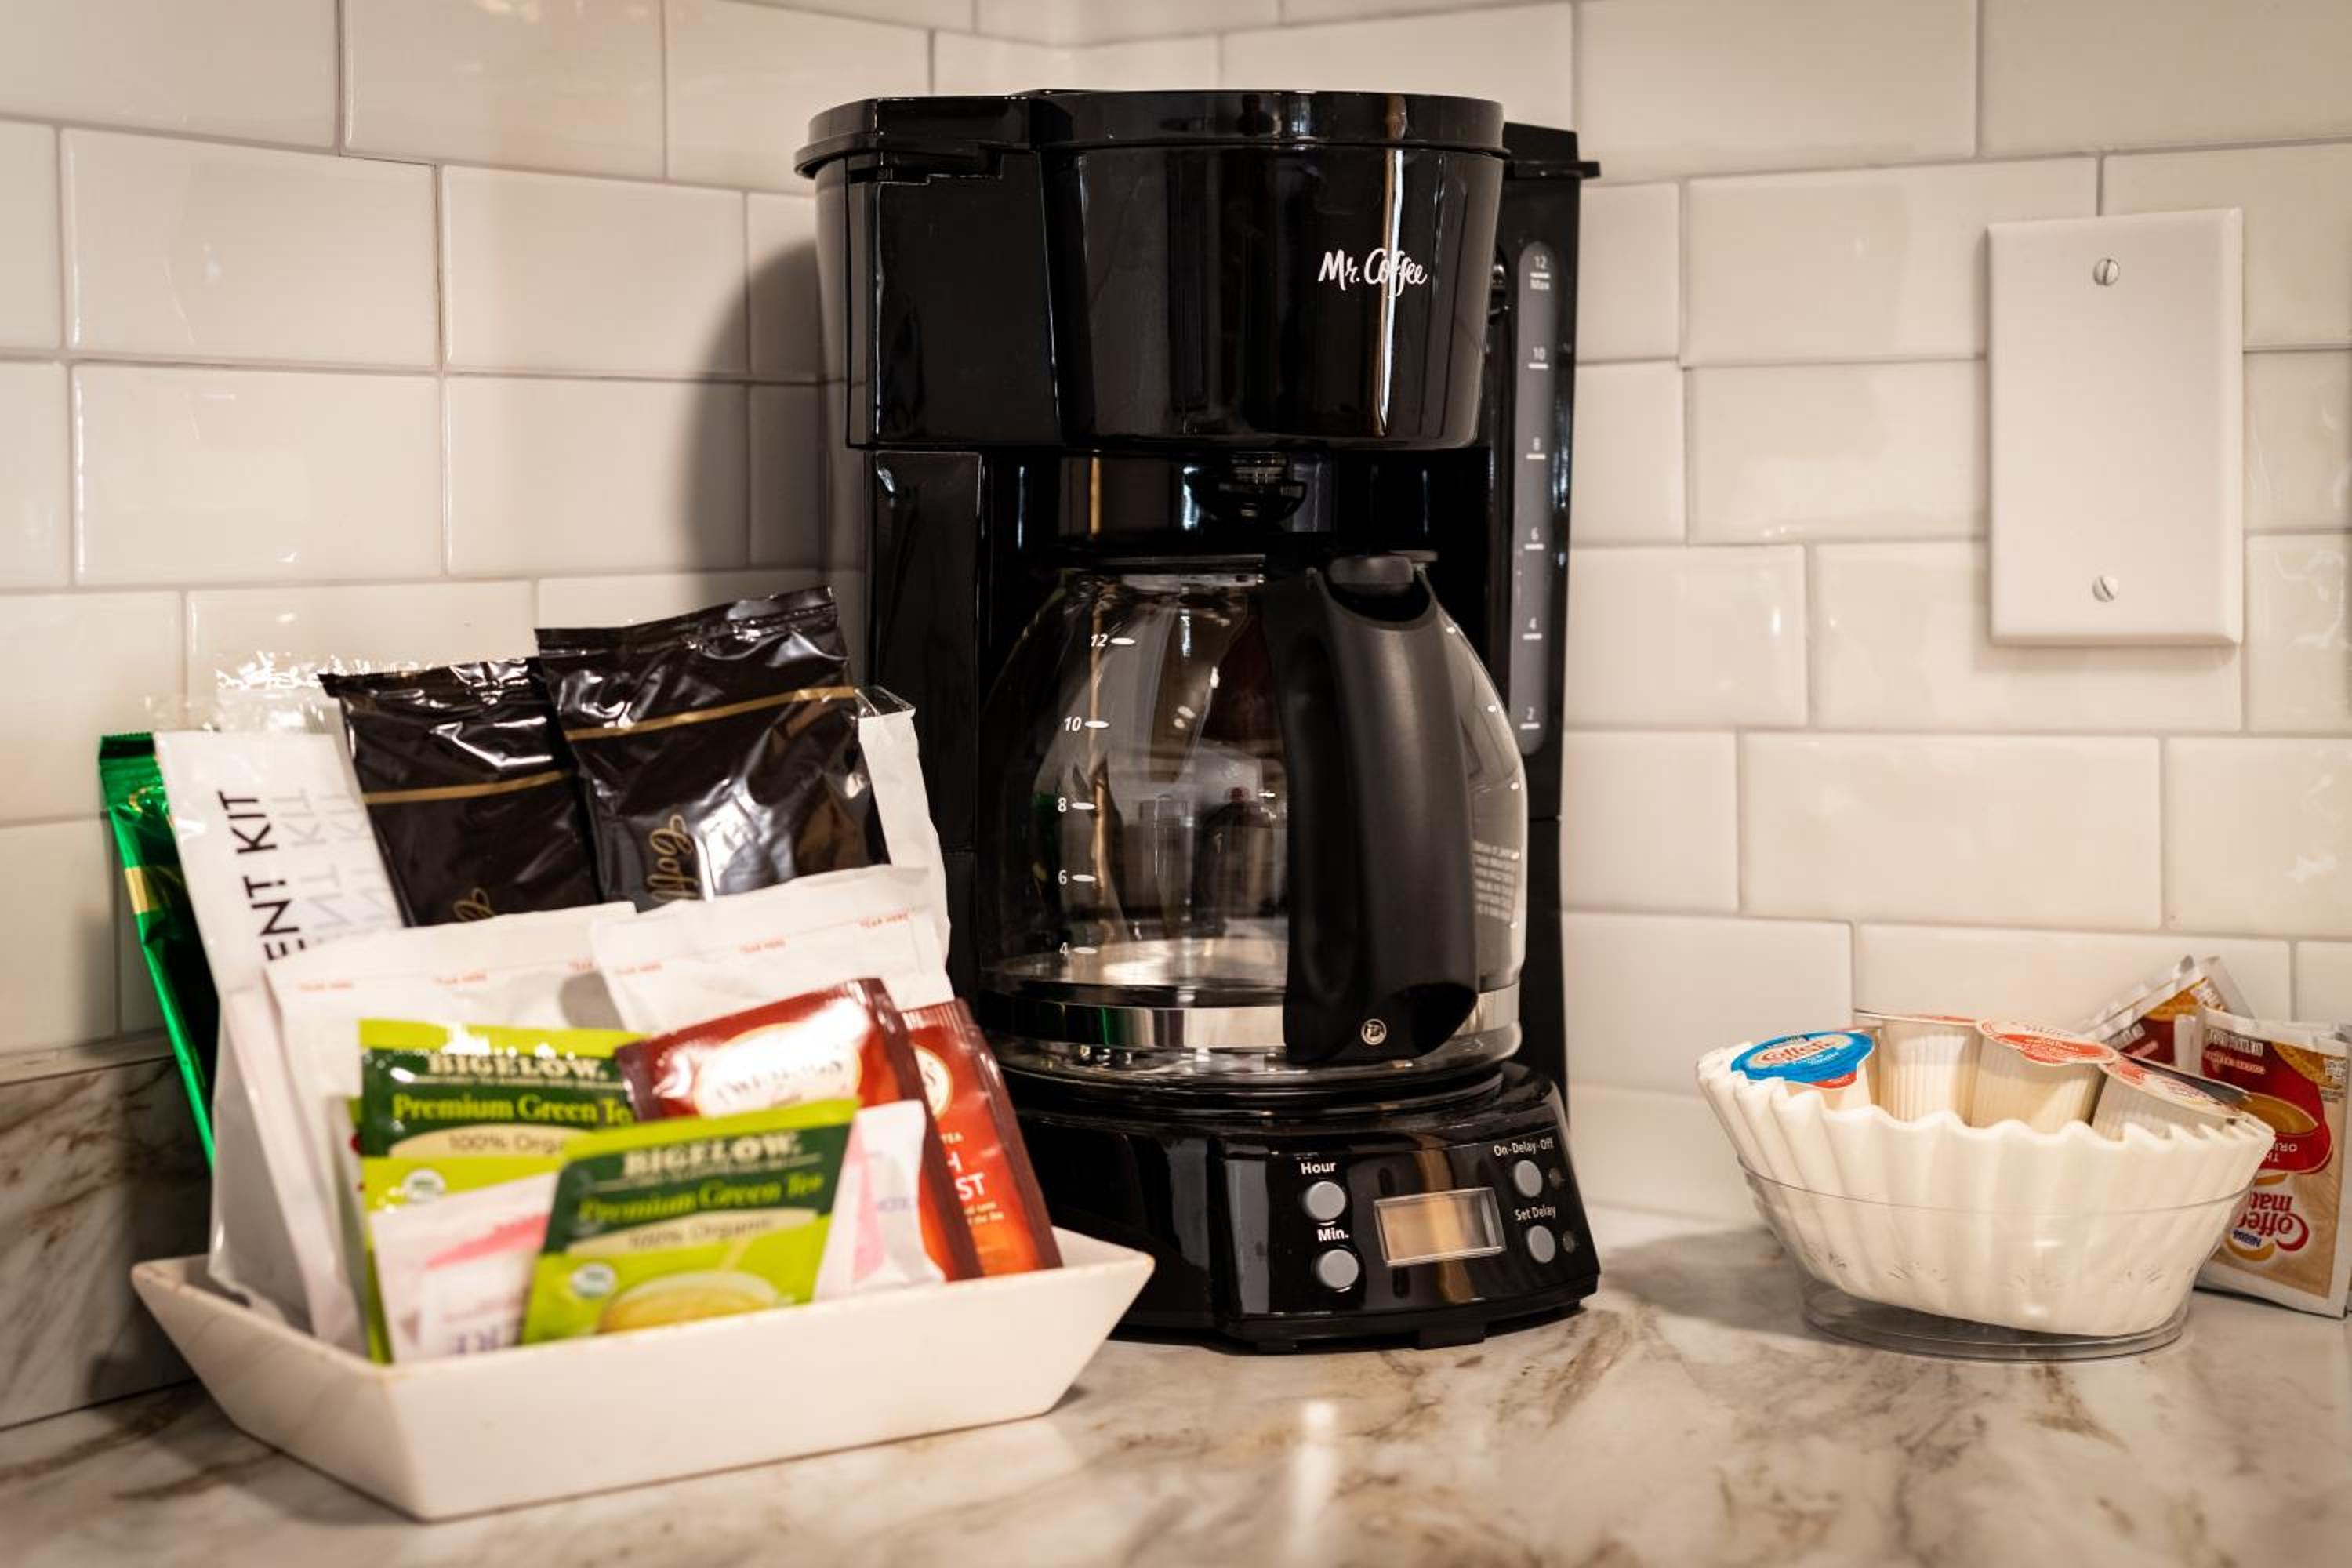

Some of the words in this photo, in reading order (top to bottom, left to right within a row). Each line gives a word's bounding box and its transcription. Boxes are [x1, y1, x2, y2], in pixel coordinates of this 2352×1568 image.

[1534, 256, 1547, 270] 12
[1318, 249, 1360, 291] Mr.
[1364, 248, 1428, 299] Coffee
[1533, 347, 1545, 360] 10
[1533, 437, 1541, 451] 8
[1530, 527, 1538, 541] 6
[1530, 617, 1537, 630] 4
[1091, 633, 1108, 647] 12
[1527, 707, 1534, 720] 2
[1064, 717, 1082, 731] 10
[1058, 797, 1067, 812] 8
[218, 790, 278, 854] KIT
[648, 815, 700, 901] Coff
[1058, 869, 1067, 884] 6
[243, 875, 306, 961] ENT
[1059, 942, 1069, 955] 4
[393, 1094, 514, 1121] Premium
[517, 1094, 598, 1123] Green
[602, 1098, 633, 1125] Te
[448, 1134, 508, 1154] 100%
[2274, 1142, 2298, 1153] ORI
[2264, 1152, 2279, 1163] TH
[1301, 1161, 1336, 1174] Hour
[578, 1193, 696, 1225] Premium
[698, 1180, 782, 1210] Green
[787, 1172, 824, 1196] Tea
[2250, 1192, 2293, 1213] mat
[1515, 1208, 1531, 1221] Set
[1532, 1204, 1556, 1219] Delay
[1317, 1227, 1349, 1242] Min.
